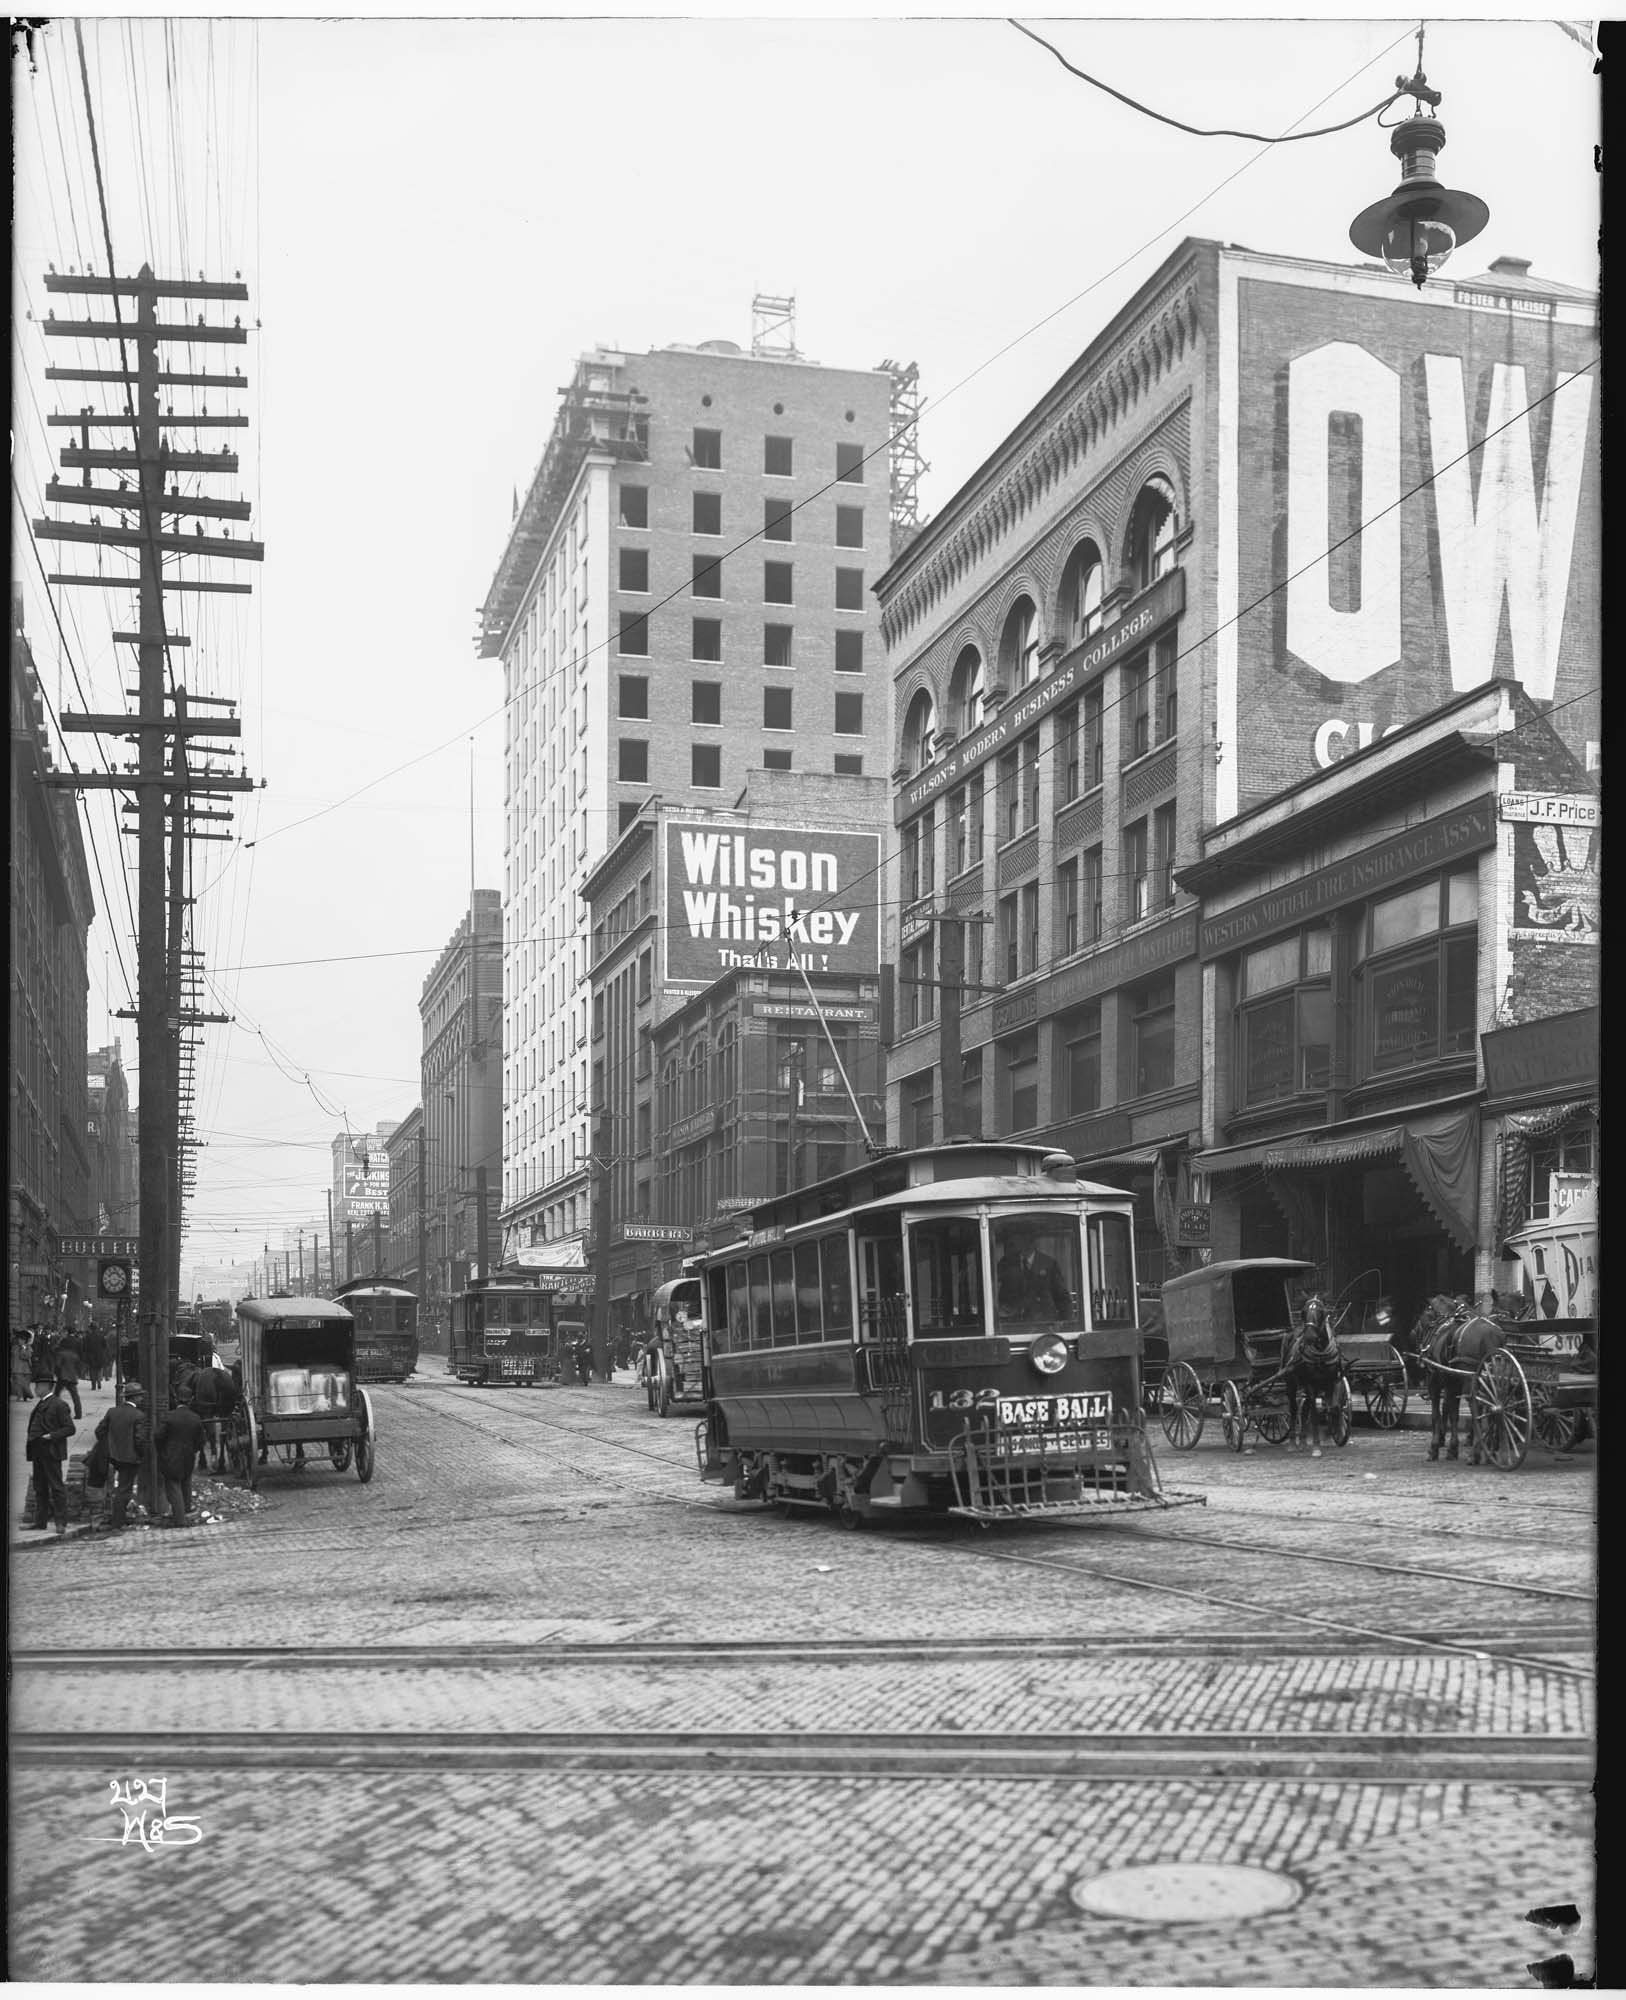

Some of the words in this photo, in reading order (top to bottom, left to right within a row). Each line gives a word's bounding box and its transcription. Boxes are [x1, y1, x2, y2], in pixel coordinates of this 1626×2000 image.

[1457, 290, 1495, 307] FOSTER
[962, 722, 1007, 767] MODERN
[1013, 668, 1075, 728] BUSINESS
[680, 831, 838, 893] Wilson
[1315, 872, 1348, 902] FIRE
[1351, 835, 1433, 890] INSURANCE
[682, 890, 860, 945] Whiskey
[1001, 1400, 1049, 1425] BASE
[1057, 1397, 1106, 1420] BALL
